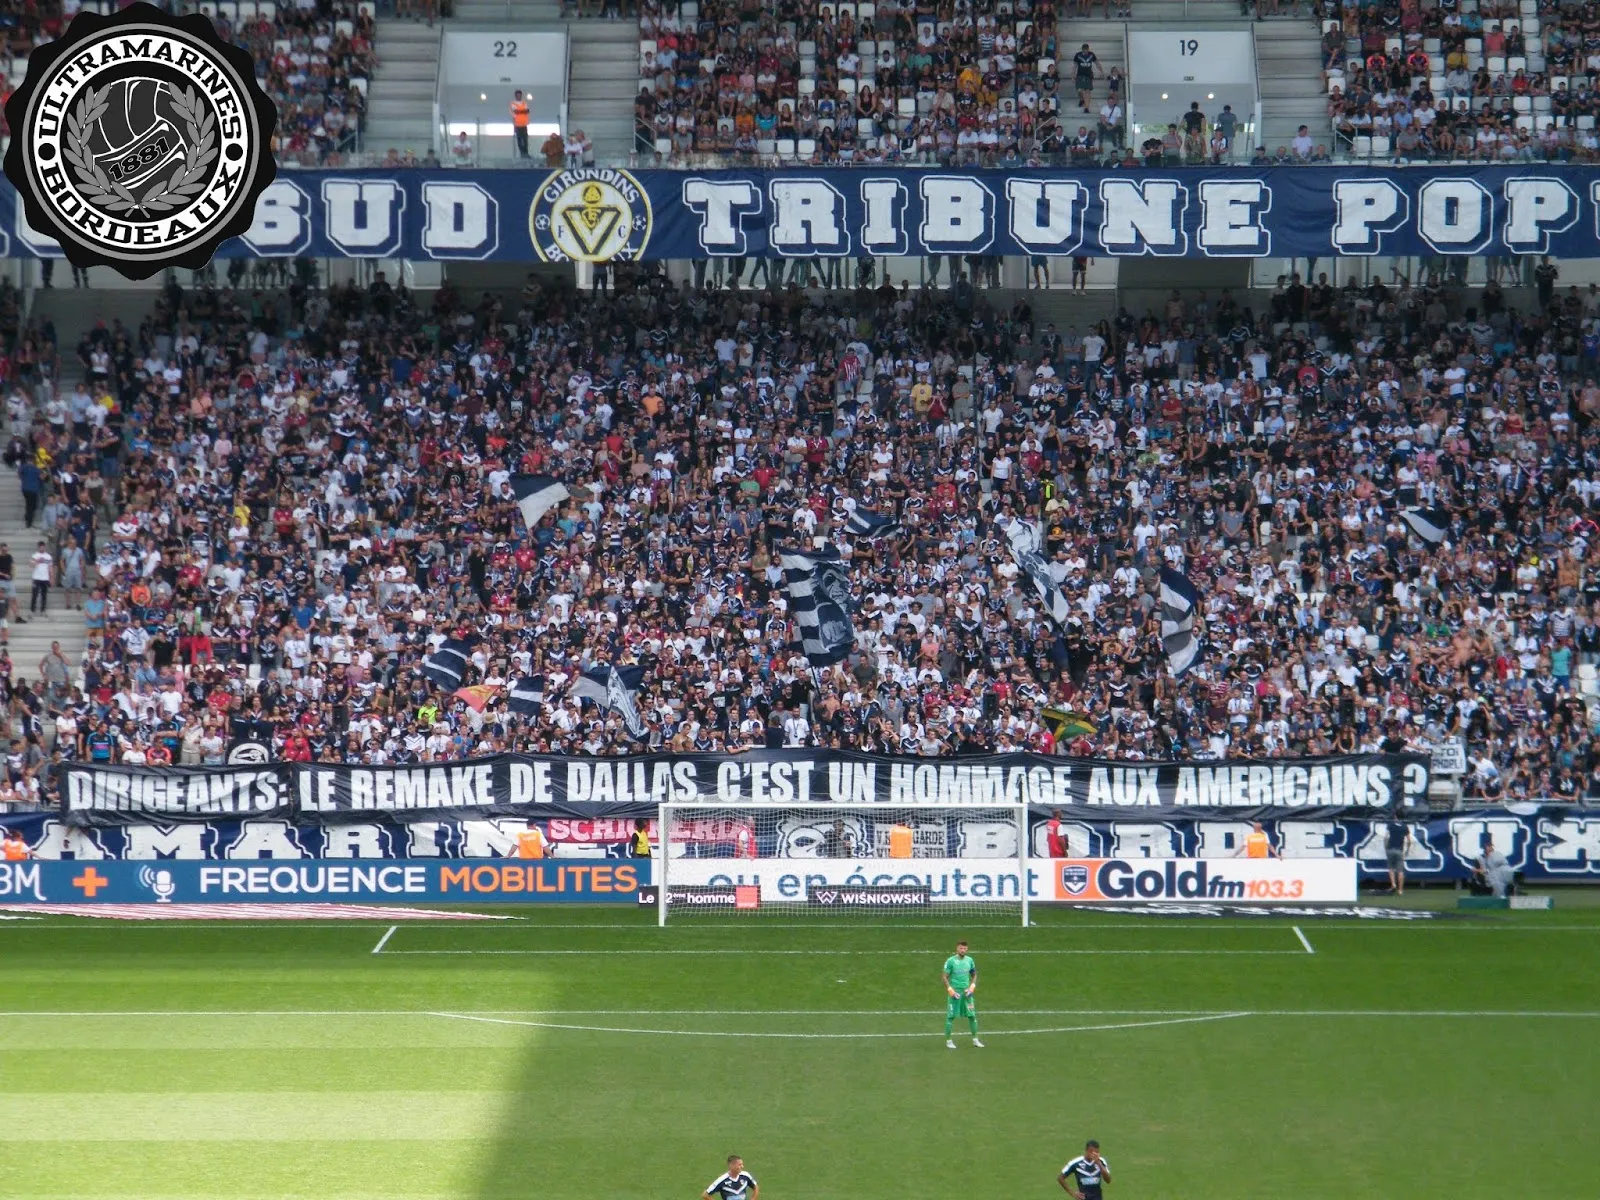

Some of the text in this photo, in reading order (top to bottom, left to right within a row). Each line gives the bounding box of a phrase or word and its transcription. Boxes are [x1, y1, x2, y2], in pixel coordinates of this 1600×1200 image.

[493, 40, 518, 58] 22
[1179, 39, 1199, 56] 19
[543, 169, 640, 204] GIRONDINS
[683, 177, 1600, 257] TRIBUNE POP
[68, 769, 288, 813] DIRIGEANTS:
[299, 768, 336, 811] LE
[352, 764, 495, 810] REMAKE
[509, 761, 552, 804] DE
[717, 761, 815, 802] C'EST
[829, 761, 877, 803] UN
[889, 764, 1073, 804] HOMMAGE
[1086, 767, 1159, 807] AUX
[1173, 764, 1393, 807] AMERICAINS
[1402, 763, 1428, 806] ?
[200, 865, 638, 894] FREQUENCE MOBILITES
[1098, 859, 1209, 899] Gold
[1246, 879, 1304, 898] 103.3
[638, 892, 655, 904] Le
[687, 891, 736, 904] homme
[840, 891, 925, 904] WIŚNIOWSKI
